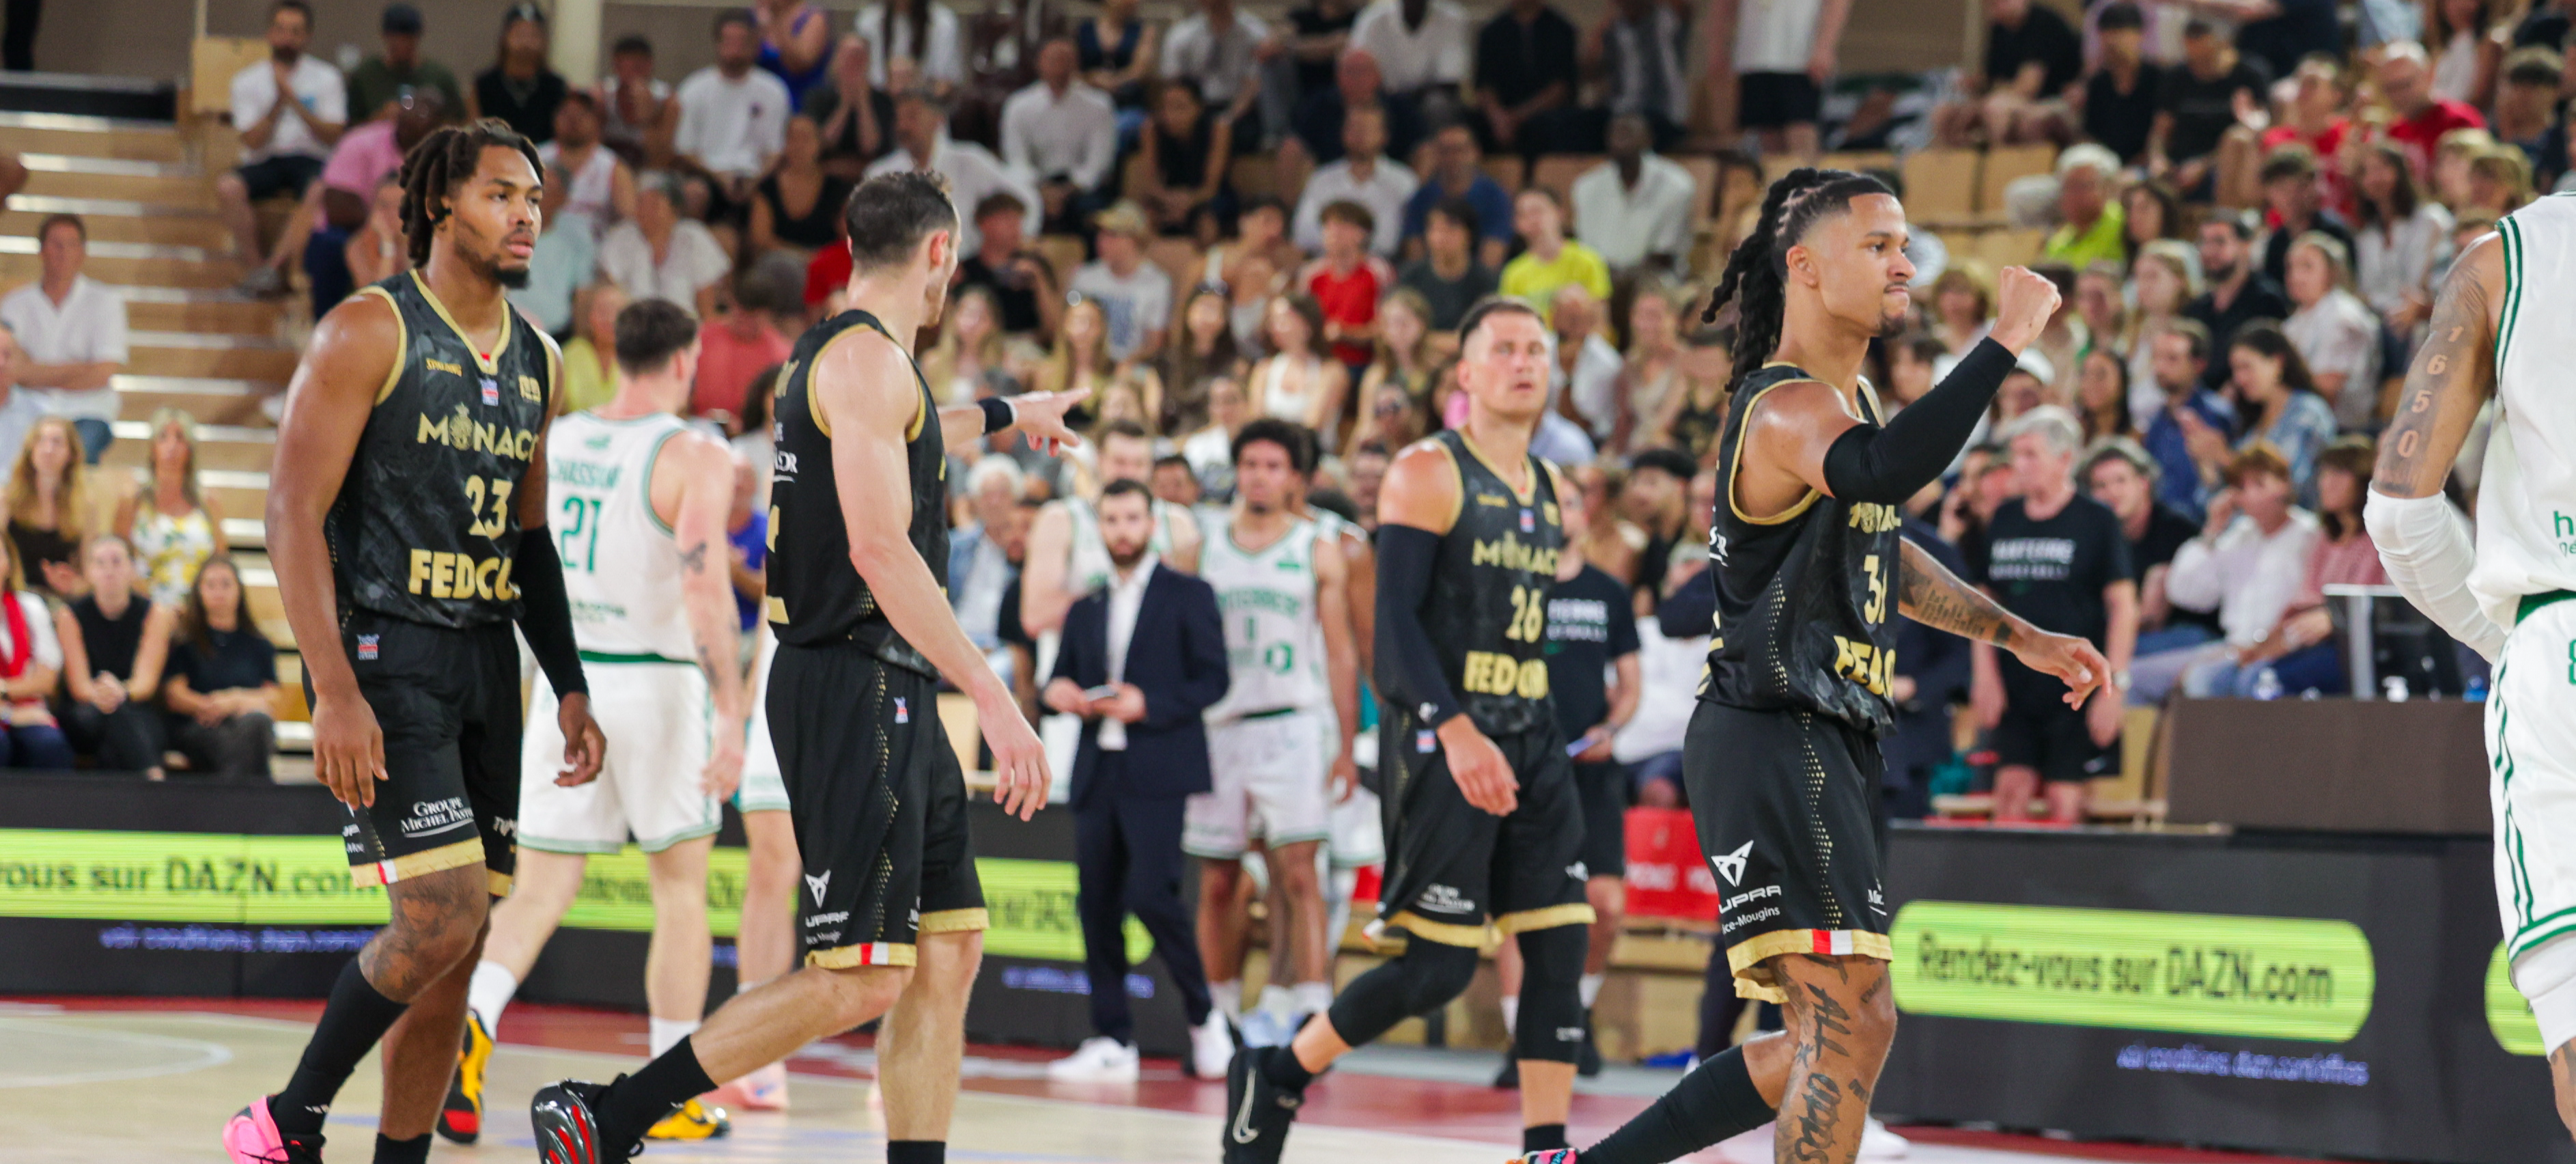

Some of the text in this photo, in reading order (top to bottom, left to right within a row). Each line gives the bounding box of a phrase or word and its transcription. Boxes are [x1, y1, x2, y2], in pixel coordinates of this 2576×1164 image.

[465, 474, 513, 541] 23
[560, 497, 601, 573] 21
[1505, 584, 1543, 643] 26
[0, 862, 76, 888] ous
[90, 865, 150, 889] sur
[1918, 930, 2334, 1002] Rendez-vous sur DAZN.com
